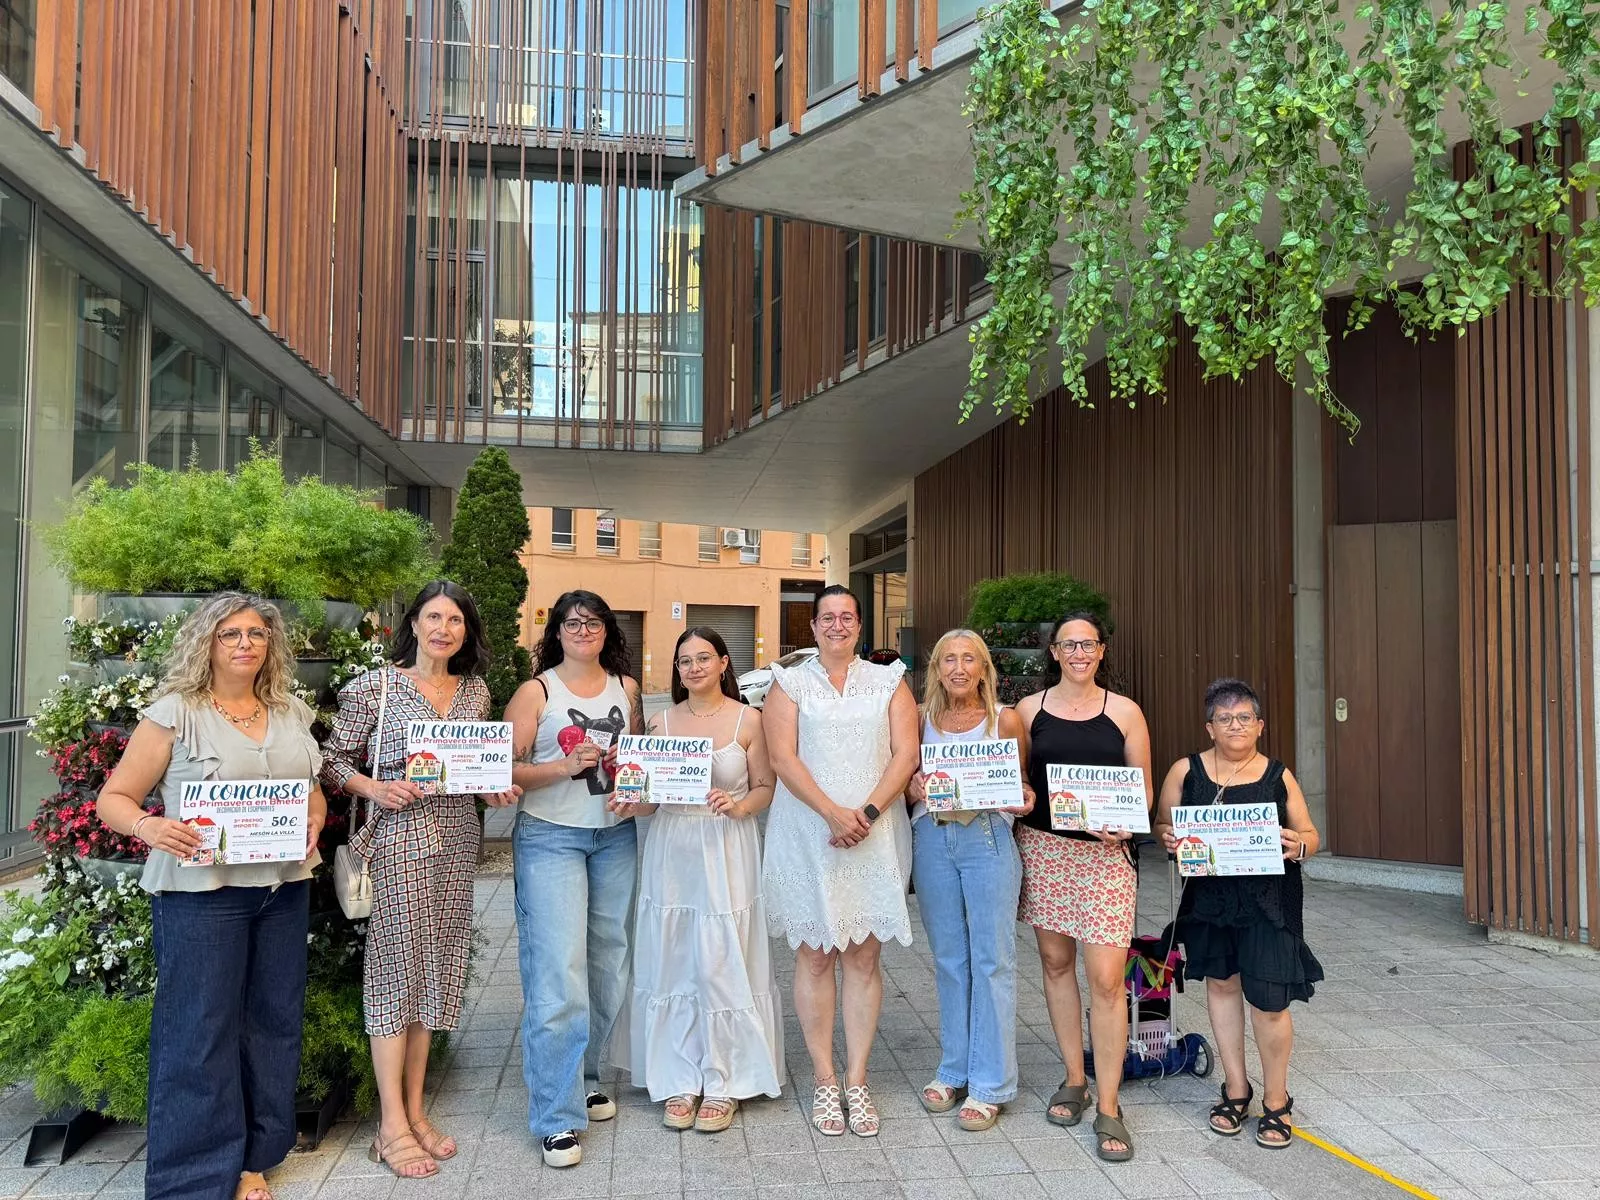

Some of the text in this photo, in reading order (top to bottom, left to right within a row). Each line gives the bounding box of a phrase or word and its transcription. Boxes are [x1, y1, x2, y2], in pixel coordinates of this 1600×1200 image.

[411, 724, 511, 738] III CONCURSO
[620, 737, 633, 750] III
[638, 738, 711, 753] CONCURSO
[925, 742, 1016, 759] III CONCURSO
[1050, 766, 1142, 782] III CONCURSO
[1062, 778, 1100, 786] Primavera
[185, 782, 307, 802] III CONCURSO
[184, 800, 197, 808] La
[200, 799, 252, 808] Primavera
[1176, 806, 1276, 822] III CONCURSO
